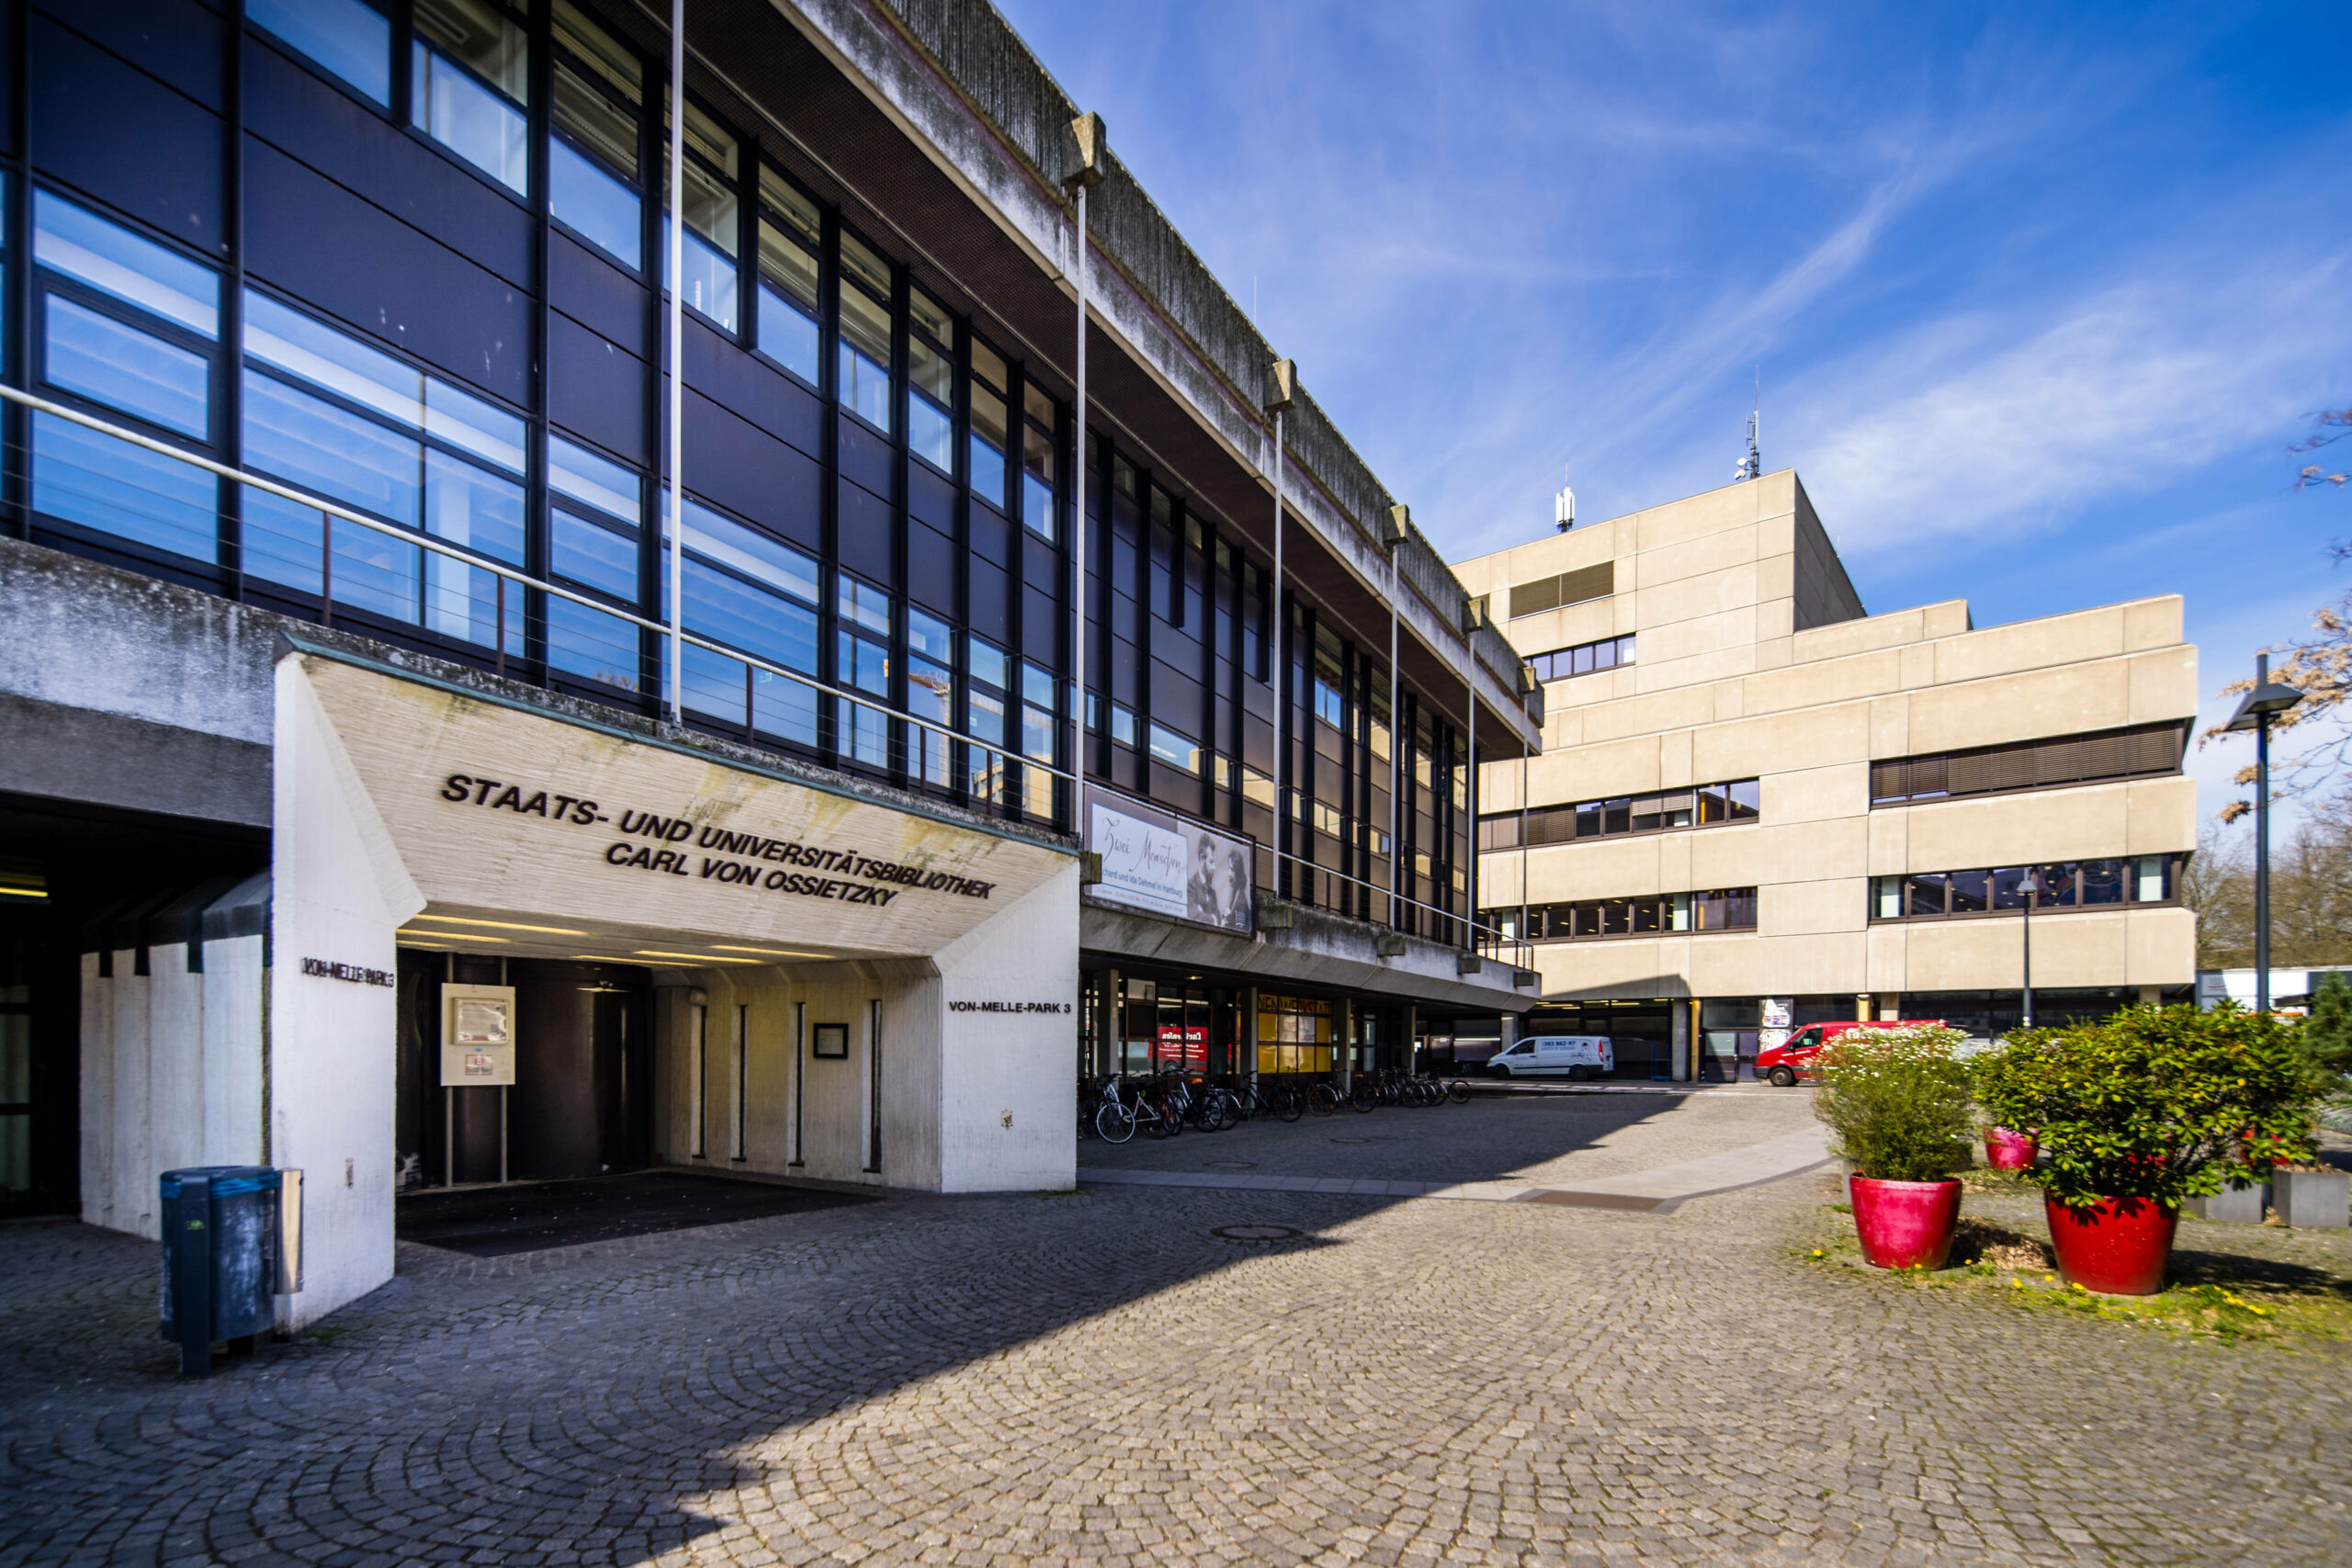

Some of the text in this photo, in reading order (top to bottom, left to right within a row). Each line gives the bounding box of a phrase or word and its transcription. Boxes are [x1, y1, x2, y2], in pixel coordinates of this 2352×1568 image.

[441, 774, 997, 899] STAATS- UND UNIVERSITÄTSBIBLIOTHEK
[606, 842, 899, 907] CARL VON OSSIETZKY
[949, 1001, 1071, 1013] VON-MELLE-PARK 3
